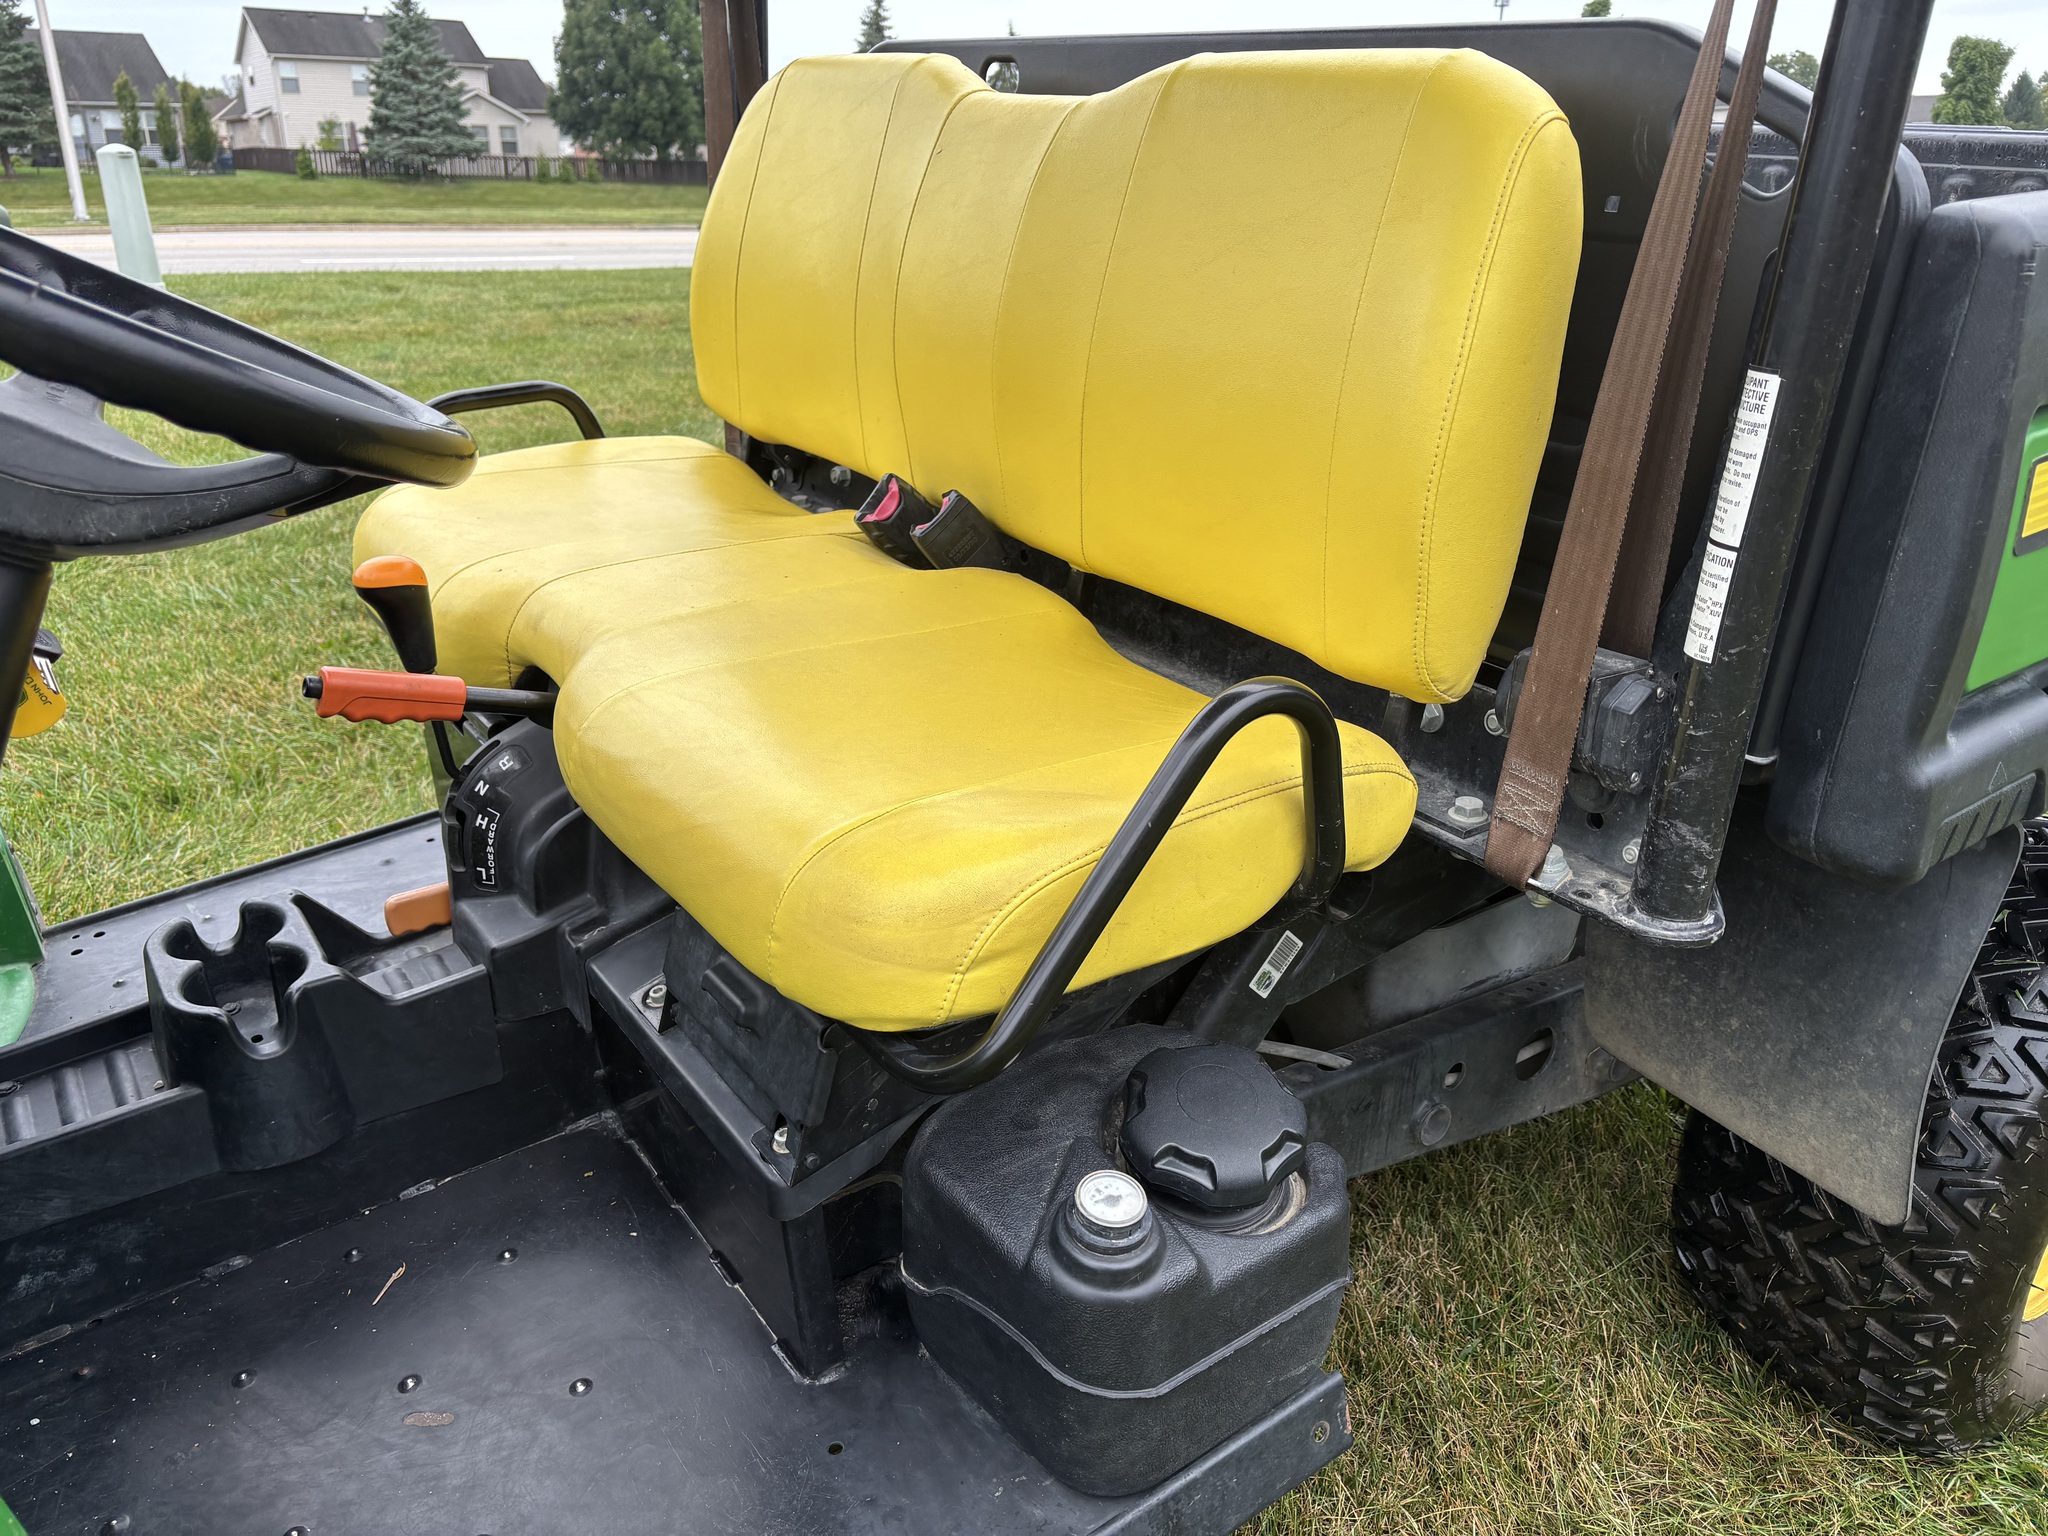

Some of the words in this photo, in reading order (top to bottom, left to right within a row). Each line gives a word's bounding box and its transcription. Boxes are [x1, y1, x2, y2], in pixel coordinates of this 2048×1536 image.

[1743, 419, 1767, 430] occupant
[1747, 427, 1758, 437] OPS
[1734, 448, 1757, 460] damaged
[1733, 469, 1740, 477] Do
[1741, 470, 1751, 480] not
[1707, 571, 1728, 583] certified
[1711, 599, 1723, 609] HPX
[1709, 609, 1722, 618] XUV
[31, 684, 52, 705] JOHN
[499, 755, 514, 771] R
[474, 780, 489, 796] N
[476, 814, 488, 829] H
[486, 823, 497, 875] FORWARD
[476, 867, 486, 880] L
